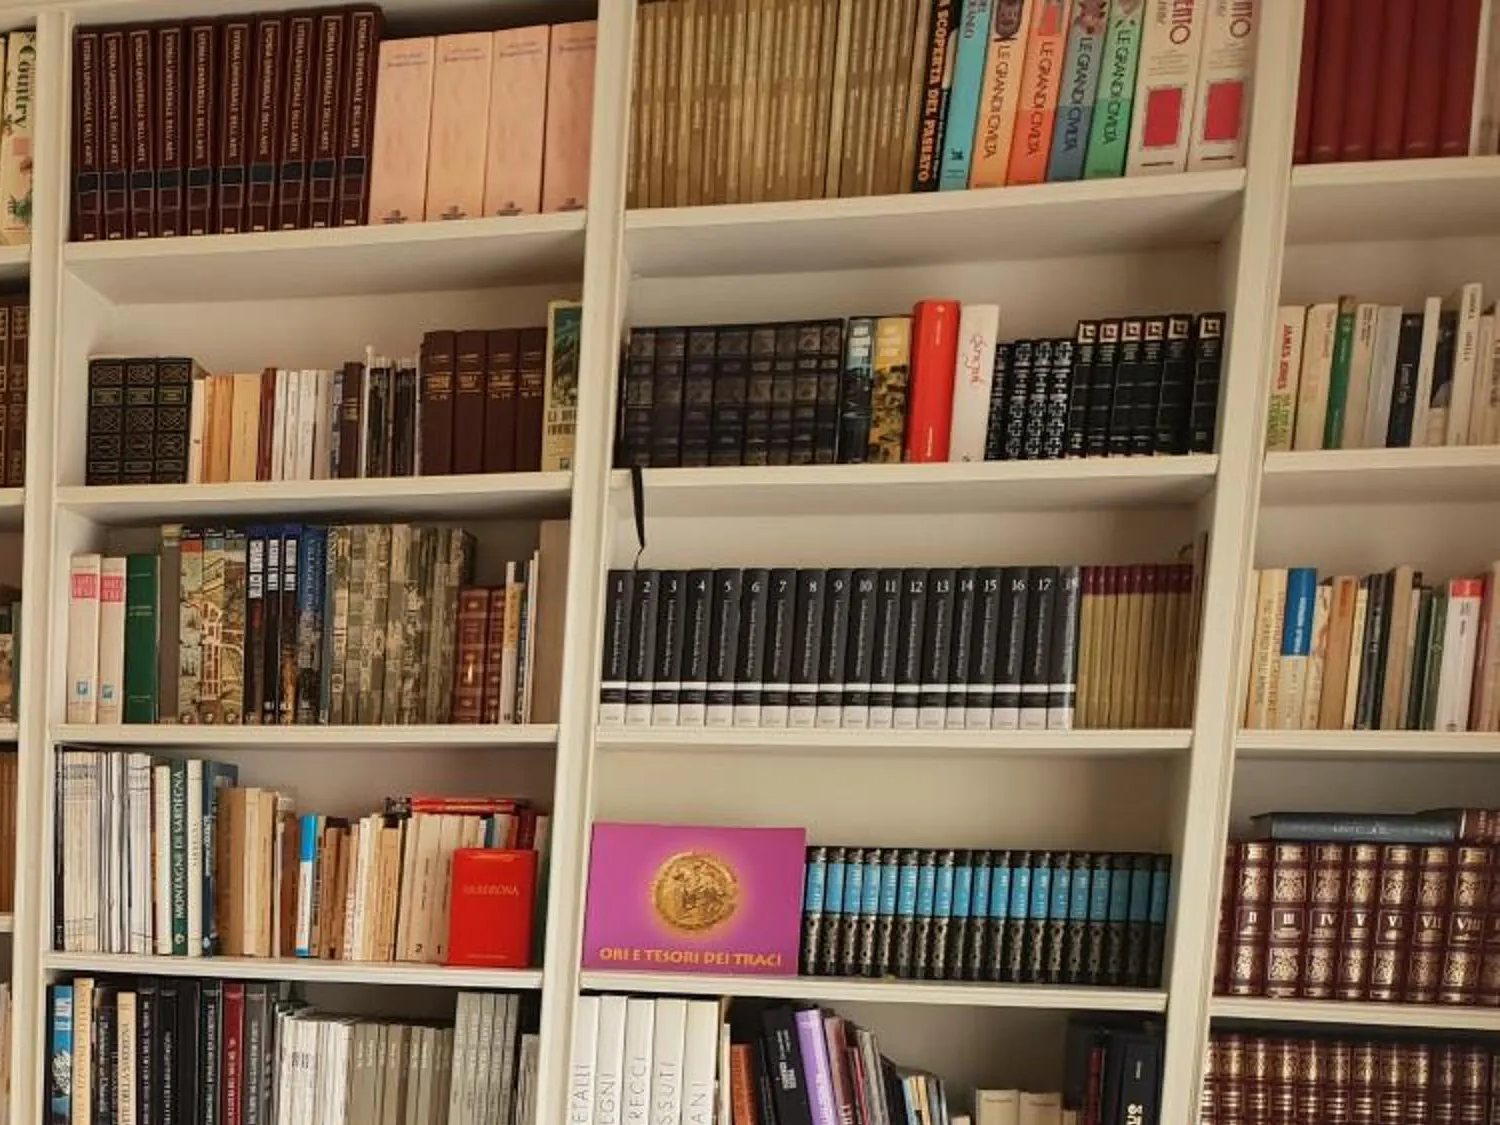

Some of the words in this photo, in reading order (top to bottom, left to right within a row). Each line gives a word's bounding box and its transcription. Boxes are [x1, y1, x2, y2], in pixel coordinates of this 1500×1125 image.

[1121, 30, 1131, 44] LE
[929, 10, 949, 84] SCOPERTA
[1042, 42, 1053, 57] LE
[1079, 38, 1092, 53] LE
[998, 46, 1009, 58] LE
[1110, 47, 1129, 97] GRANDI
[1032, 59, 1052, 108] GRANDI
[1070, 54, 1091, 104] GRANDI
[16, 45, 36, 128] Country
[990, 62, 1009, 113] GRANDI
[925, 89, 940, 116] DEL
[918, 120, 936, 182] PASSATO
[1281, 325, 1293, 358] JAMES
[618, 581, 624, 592] 1
[642, 582, 651, 594] 2
[669, 581, 677, 593] 3
[698, 581, 706, 593] 4
[724, 581, 732, 593] 5
[752, 581, 760, 592] 6
[778, 581, 786, 593] 7
[809, 581, 817, 593] 8
[834, 580, 843, 593] 9
[859, 580, 872, 592] 10
[885, 580, 897, 592] 11
[910, 581, 923, 593] 12
[936, 581, 950, 593] 13
[961, 580, 974, 592] 14
[984, 580, 996, 592] 15
[1012, 580, 1024, 592] 16
[1038, 578, 1052, 592] 17
[173, 771, 184, 832] SARDEGNA
[174, 835, 184, 849] DI
[173, 852, 185, 918] MONTAGNE
[1249, 912, 1257, 923] II
[1283, 913, 1295, 924] III
[1320, 914, 1334, 925] IV
[1356, 914, 1367, 925] V
[1388, 916, 1402, 926] VI
[1422, 916, 1441, 928] VII
[1457, 917, 1481, 929] VIII
[416, 943, 422, 953] 2
[600, 948, 629, 962] ORI
[634, 949, 641, 962] E
[644, 949, 700, 964] TESORI
[705, 952, 733, 965] DEI
[736, 954, 781, 966] TRACI
[122, 1023, 130, 1072] SARDEGNA
[122, 1074, 131, 1104] DELLA
